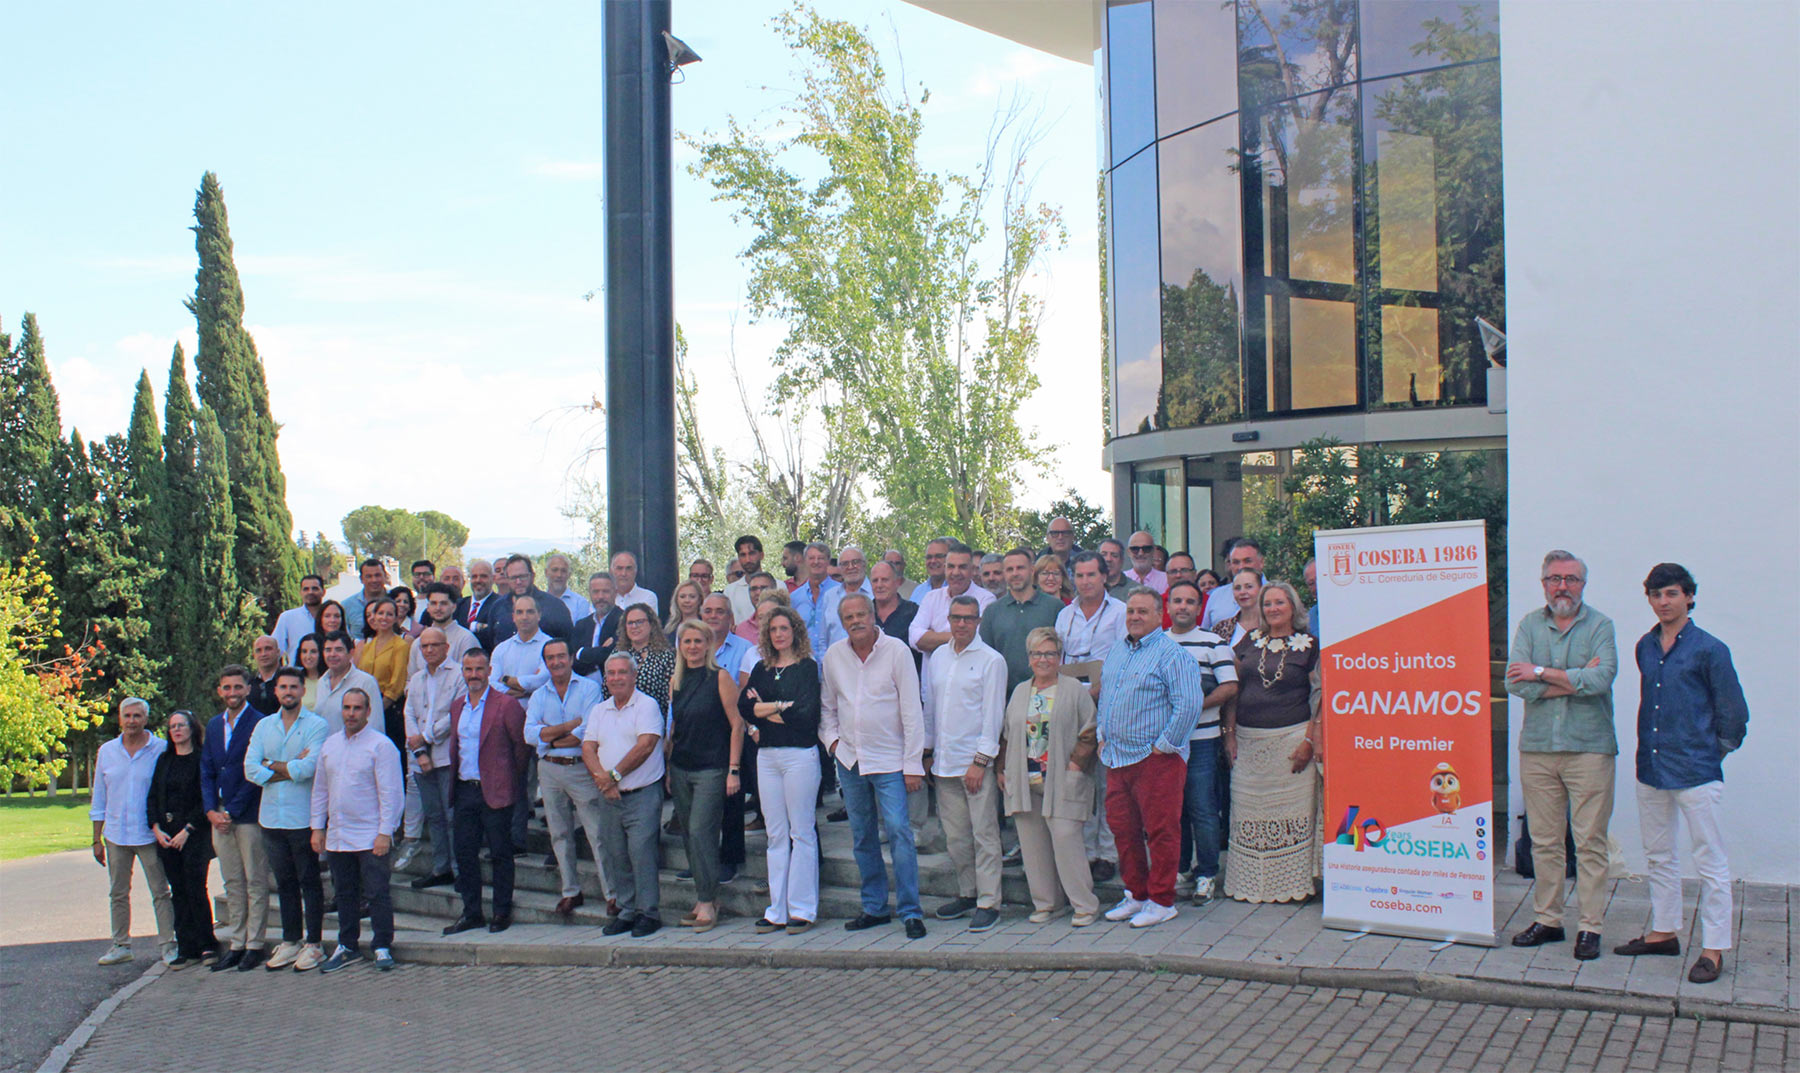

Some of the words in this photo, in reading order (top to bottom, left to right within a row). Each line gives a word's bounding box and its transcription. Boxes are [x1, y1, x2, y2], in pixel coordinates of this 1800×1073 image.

[1358, 547, 1427, 567] COSEBA
[1434, 544, 1478, 562] 1986
[1427, 572, 1438, 581] de
[1440, 571, 1478, 582] Seguros
[1332, 653, 1389, 670] Todos
[1392, 652, 1456, 673] juntos
[1331, 690, 1482, 716] GANAMOS
[1354, 736, 1384, 749] Red
[1389, 736, 1454, 751] Premier
[1441, 816, 1453, 825] IA
[1383, 839, 1471, 860] COSEBA
[1370, 899, 1443, 914] coseba.com
